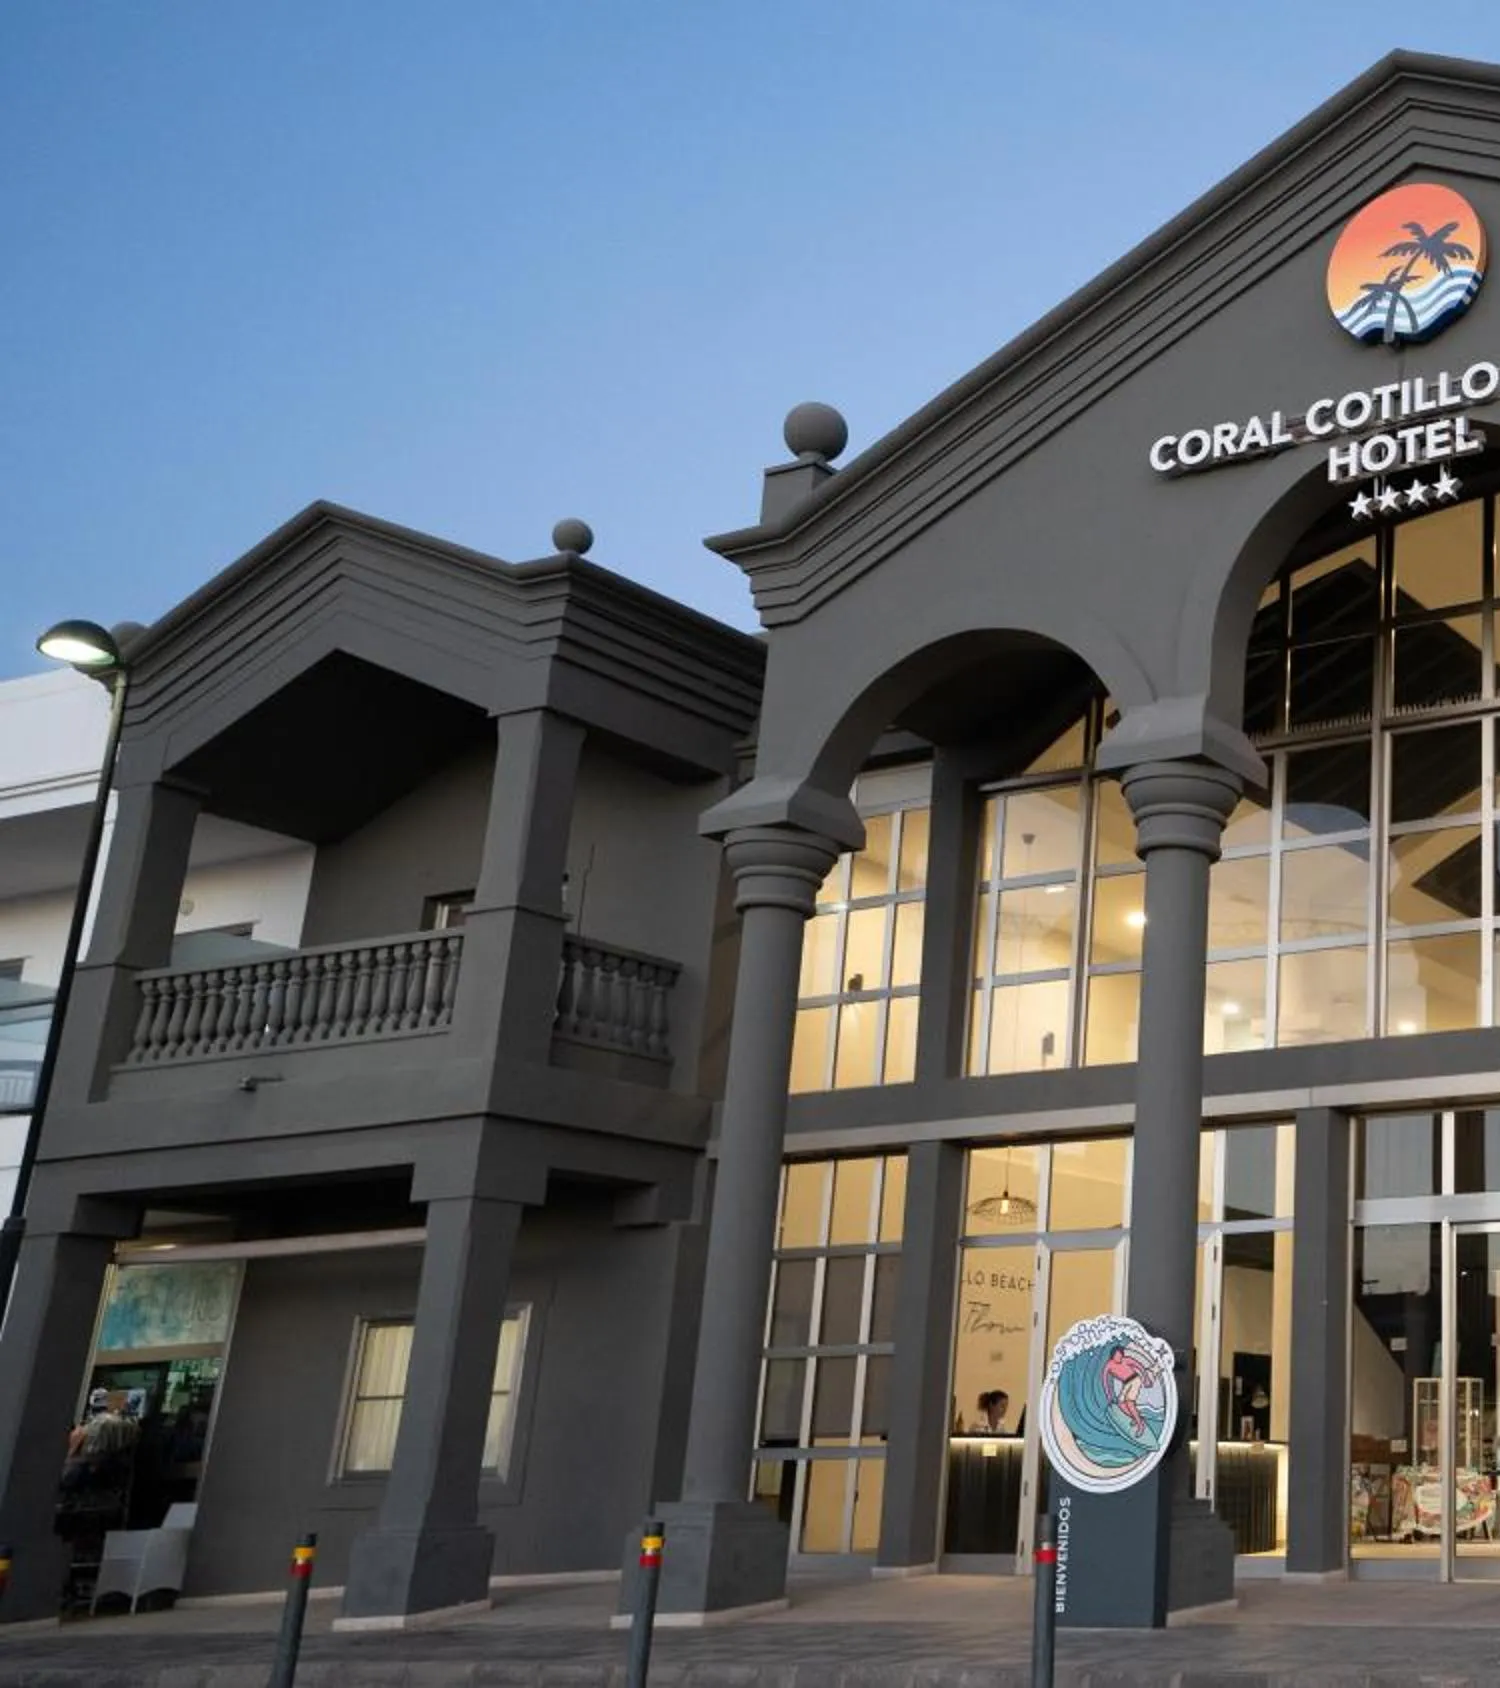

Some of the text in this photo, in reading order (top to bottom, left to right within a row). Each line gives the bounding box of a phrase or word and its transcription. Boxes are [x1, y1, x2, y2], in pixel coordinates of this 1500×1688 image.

[1150, 411, 1292, 471] CORAL
[1305, 362, 1499, 435] COTILLO
[1328, 416, 1479, 482] HOTEL
[1056, 1497, 1071, 1613] BIENVENIDOS
